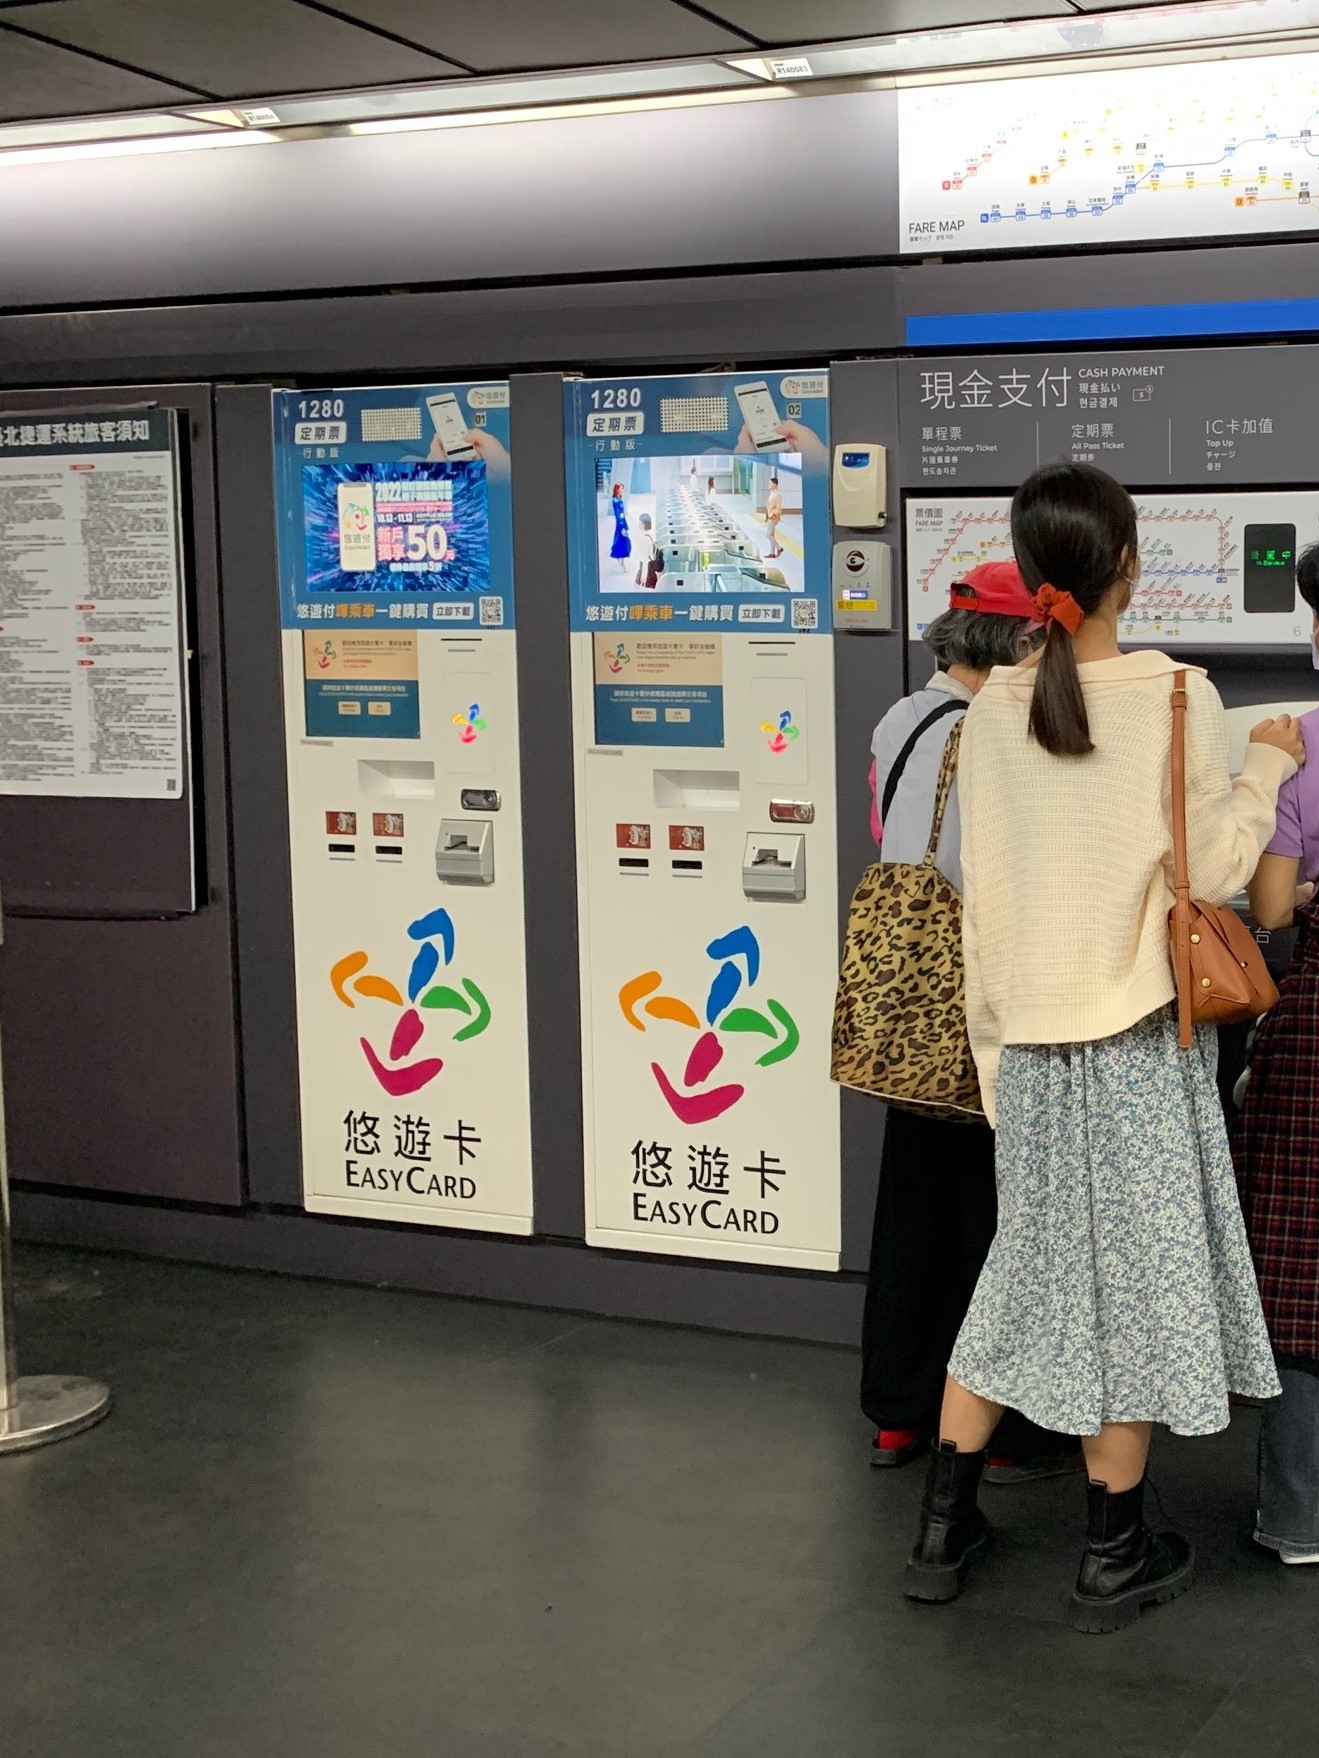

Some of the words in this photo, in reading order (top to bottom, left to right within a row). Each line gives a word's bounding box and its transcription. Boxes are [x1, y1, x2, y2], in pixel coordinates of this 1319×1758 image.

[909, 222, 936, 234] FARE
[939, 220, 965, 232] MAP
[1078, 367, 1109, 378] CASH
[1111, 365, 1165, 377] PAYMENT
[920, 366, 1073, 410] 現金支付
[1079, 382, 1121, 394] 現金払い
[591, 388, 642, 409] 1280
[1079, 397, 1118, 409] 현금결제
[298, 399, 344, 419] 1280
[788, 404, 801, 415] 02
[591, 416, 638, 432] 定期票
[1071, 423, 1114, 438] 定期票
[1205, 417, 1274, 435] IC卡加值
[0, 420, 149, 447] 北捷運系統旅客須知
[300, 426, 341, 441] 定期票
[922, 426, 962, 441] 單程票
[595, 440, 636, 452] 行動版
[922, 445, 944, 454] Single
[945, 444, 974, 454] Journey
[975, 444, 998, 452] Ticket
[1072, 442, 1081, 450] All
[1083, 442, 1100, 450] Pass
[1102, 441, 1125, 450] Ticket
[1206, 440, 1221, 449] Top
[1222, 440, 1234, 448] Up
[1206, 450, 1237, 459] チャージ
[742, 608, 781, 620] 立即下載
[1293, 626, 1302, 637] 6
[343, 1110, 482, 1166] 悠遊卡
[631, 1139, 787, 1199] 悠遊卡
